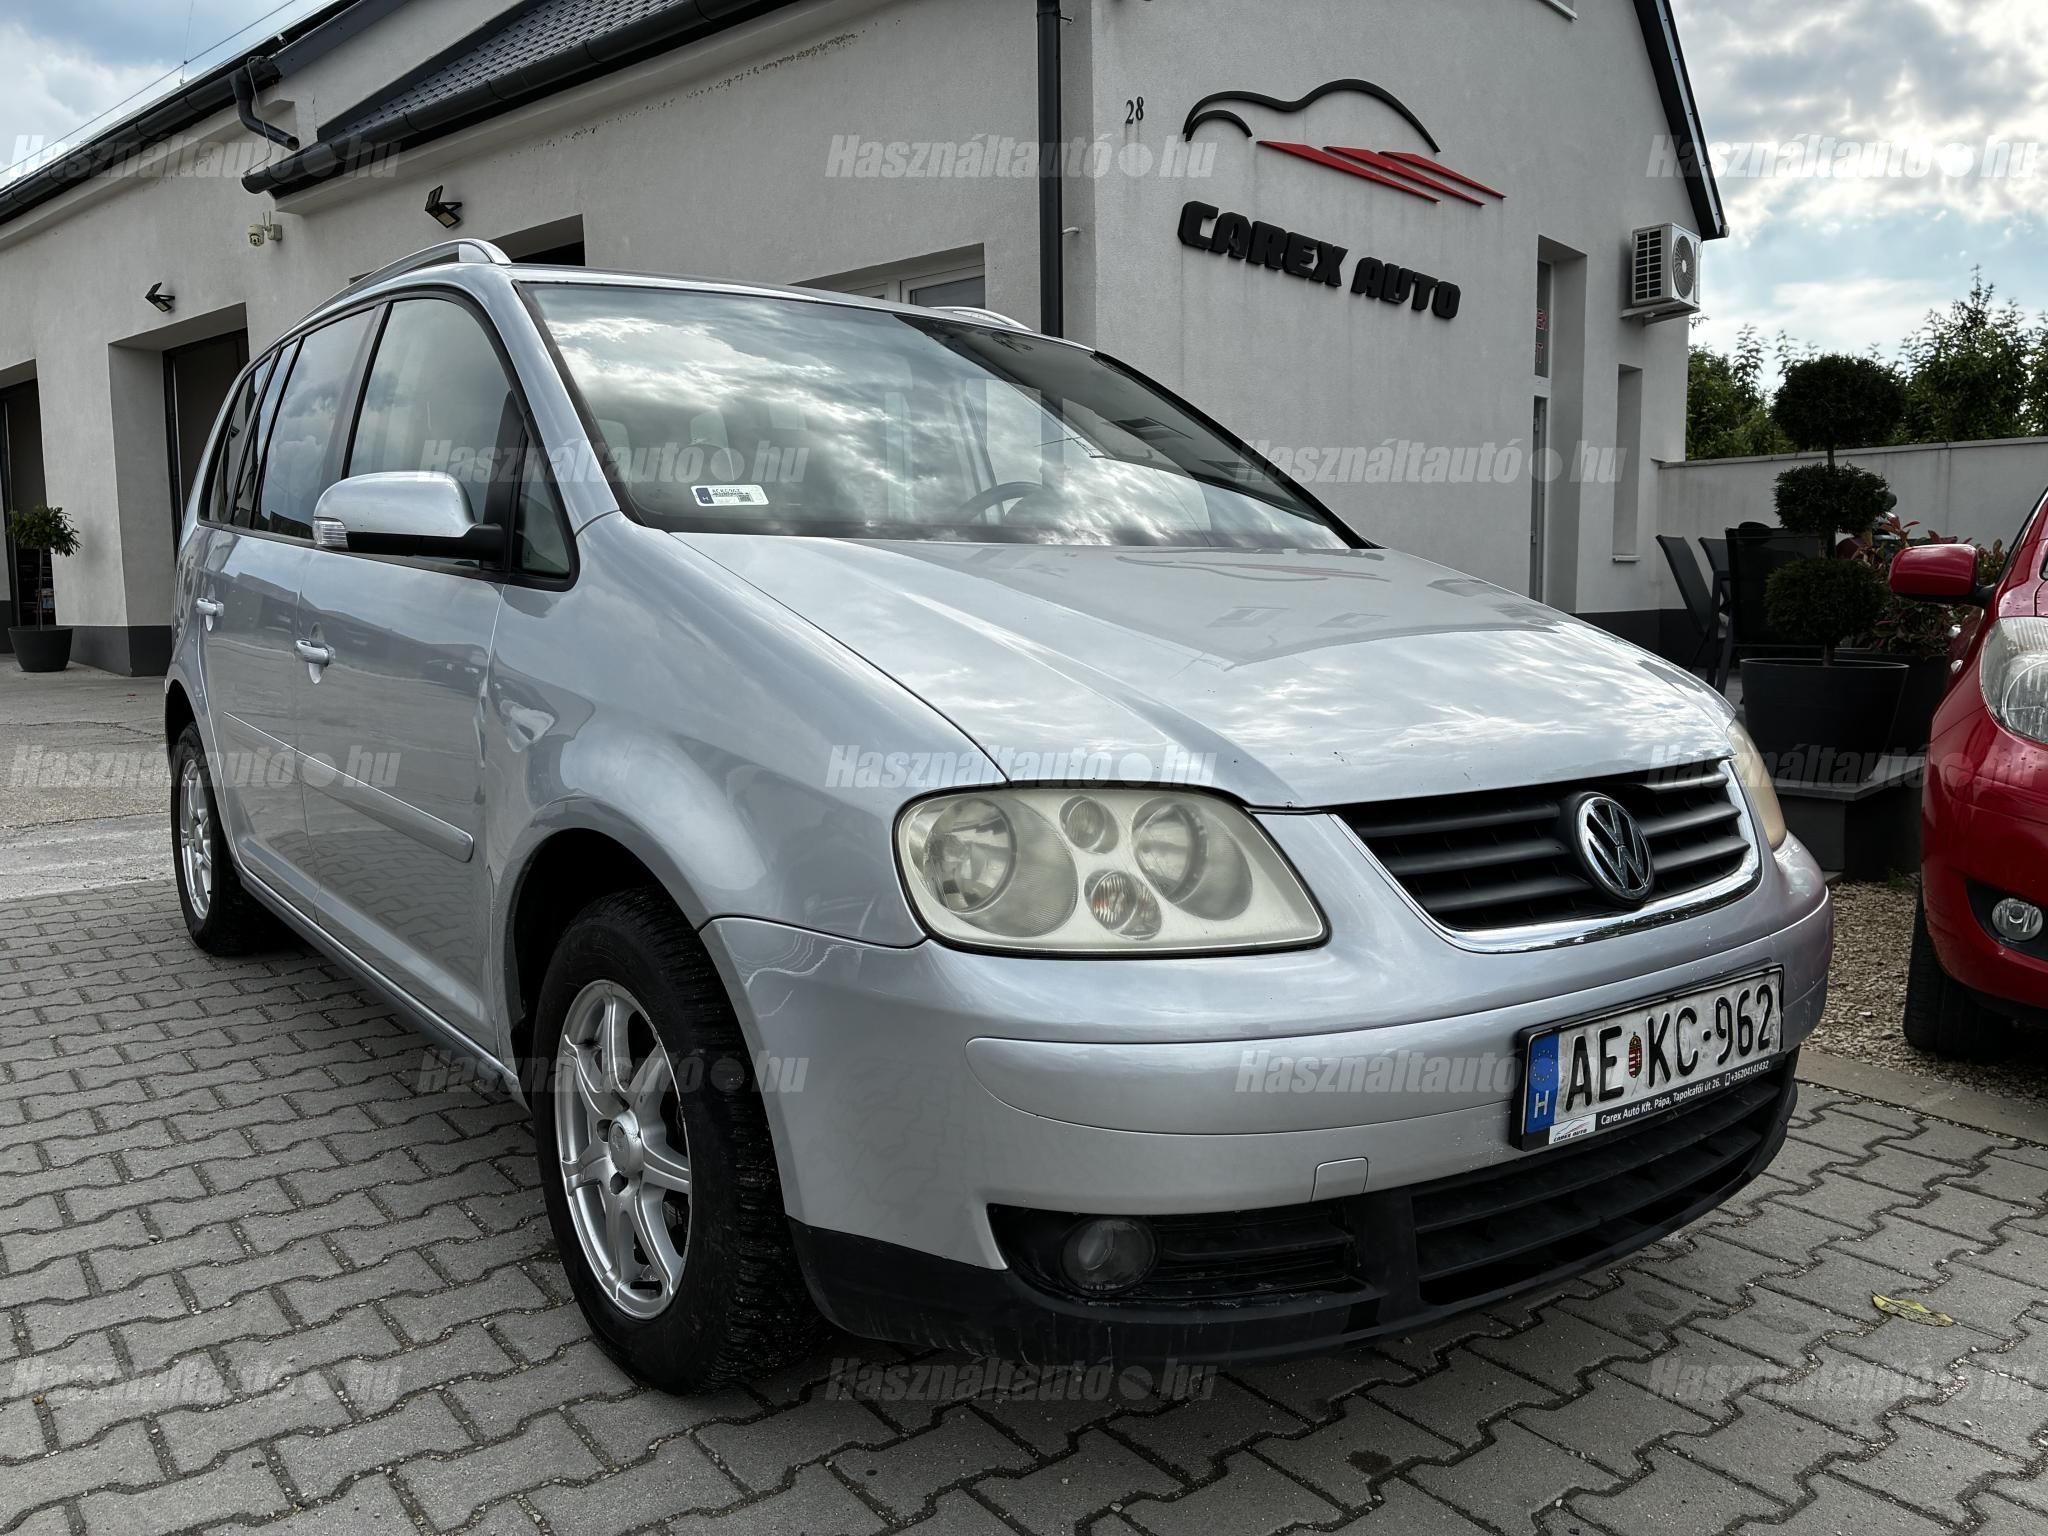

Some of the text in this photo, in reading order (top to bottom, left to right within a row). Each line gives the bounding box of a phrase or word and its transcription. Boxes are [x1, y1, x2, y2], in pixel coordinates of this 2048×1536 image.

[1125, 96, 1144, 125] 28
[1177, 200, 1461, 319] CAREX AUTO
[1566, 1025, 1624, 1111] AE
[1534, 1090, 1549, 1119] H
[1601, 1112, 1621, 1125] Carex
[1623, 1103, 1640, 1119] Autó
[1641, 1102, 1652, 1113] Kft.
[1654, 1096, 1672, 1110] Pápa,
